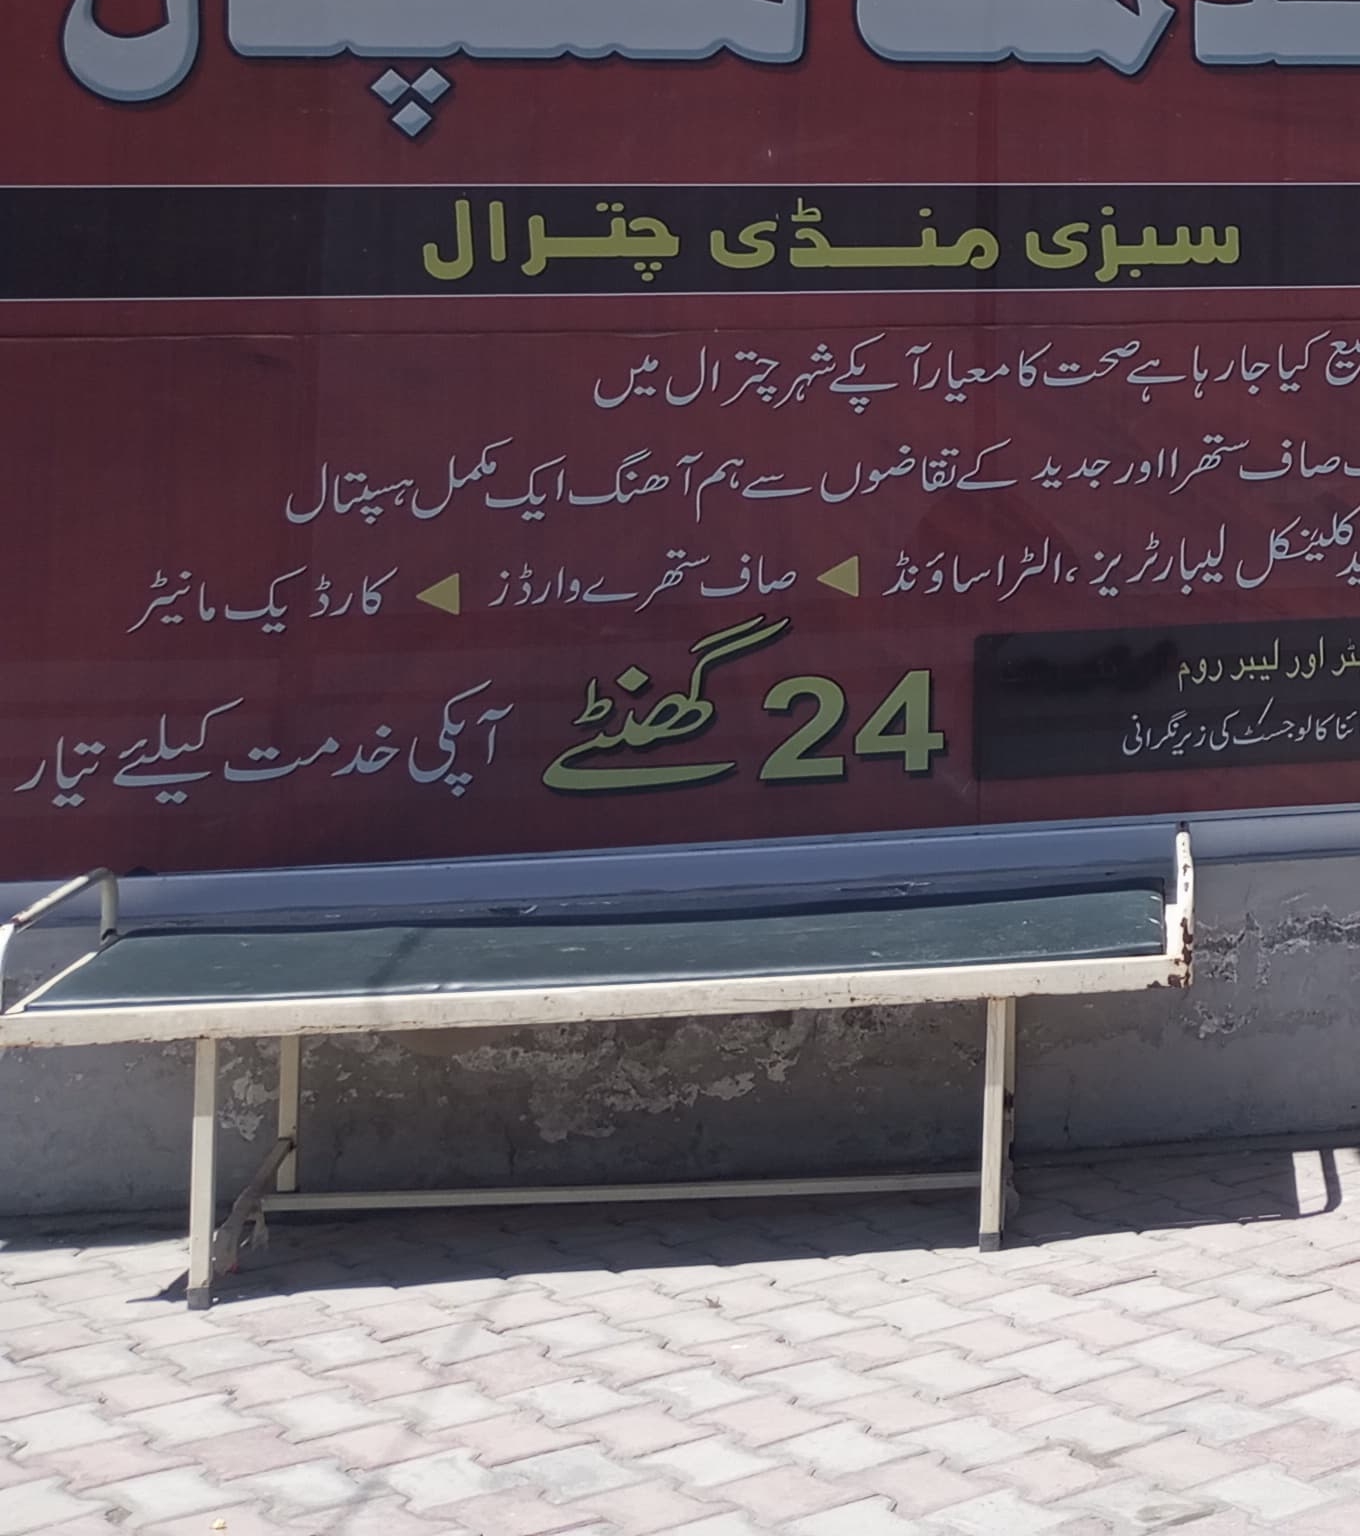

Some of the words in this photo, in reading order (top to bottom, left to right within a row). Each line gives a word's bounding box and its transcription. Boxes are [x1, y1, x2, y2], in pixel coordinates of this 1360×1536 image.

[422, 199, 680, 281] چترال
[709, 197, 999, 269] منڈی
[1024, 204, 1240, 281] سبزی
[593, 353, 659, 409] میں
[665, 346, 780, 407] چترال
[773, 343, 837, 409] شہر
[919, 349, 1010, 404] معیار
[1018, 341, 1052, 388] کا
[1043, 338, 1140, 387] صحت
[1126, 358, 1186, 402] ہے
[1278, 330, 1331, 392] کیا
[411, 436, 514, 520] مکمل
[485, 455, 567, 521] ایک
[741, 472, 812, 499] سے
[820, 445, 959, 503] تقاضوں
[957, 438, 1018, 491] کے
[1031, 455, 1111, 489] جدید
[1113, 447, 1165, 485] اور
[1239, 438, 1341, 481] صاف
[286, 461, 415, 525] ہسپتال
[696, 457, 745, 524] ہم
[489, 566, 581, 609] وارڈز
[583, 547, 709, 613] ستھرے
[702, 553, 797, 598] صاف
[1178, 657, 1223, 692] روم
[1231, 637, 1280, 680] لیبر
[1286, 636, 1325, 678] اور
[541, 616, 790, 793] گھنٹے
[760, 670, 943, 783] 24
[1210, 709, 1240, 751] کی
[13, 736, 107, 808] تیار
[113, 697, 245, 805] کیلئے
[223, 725, 401, 782] خدمت
